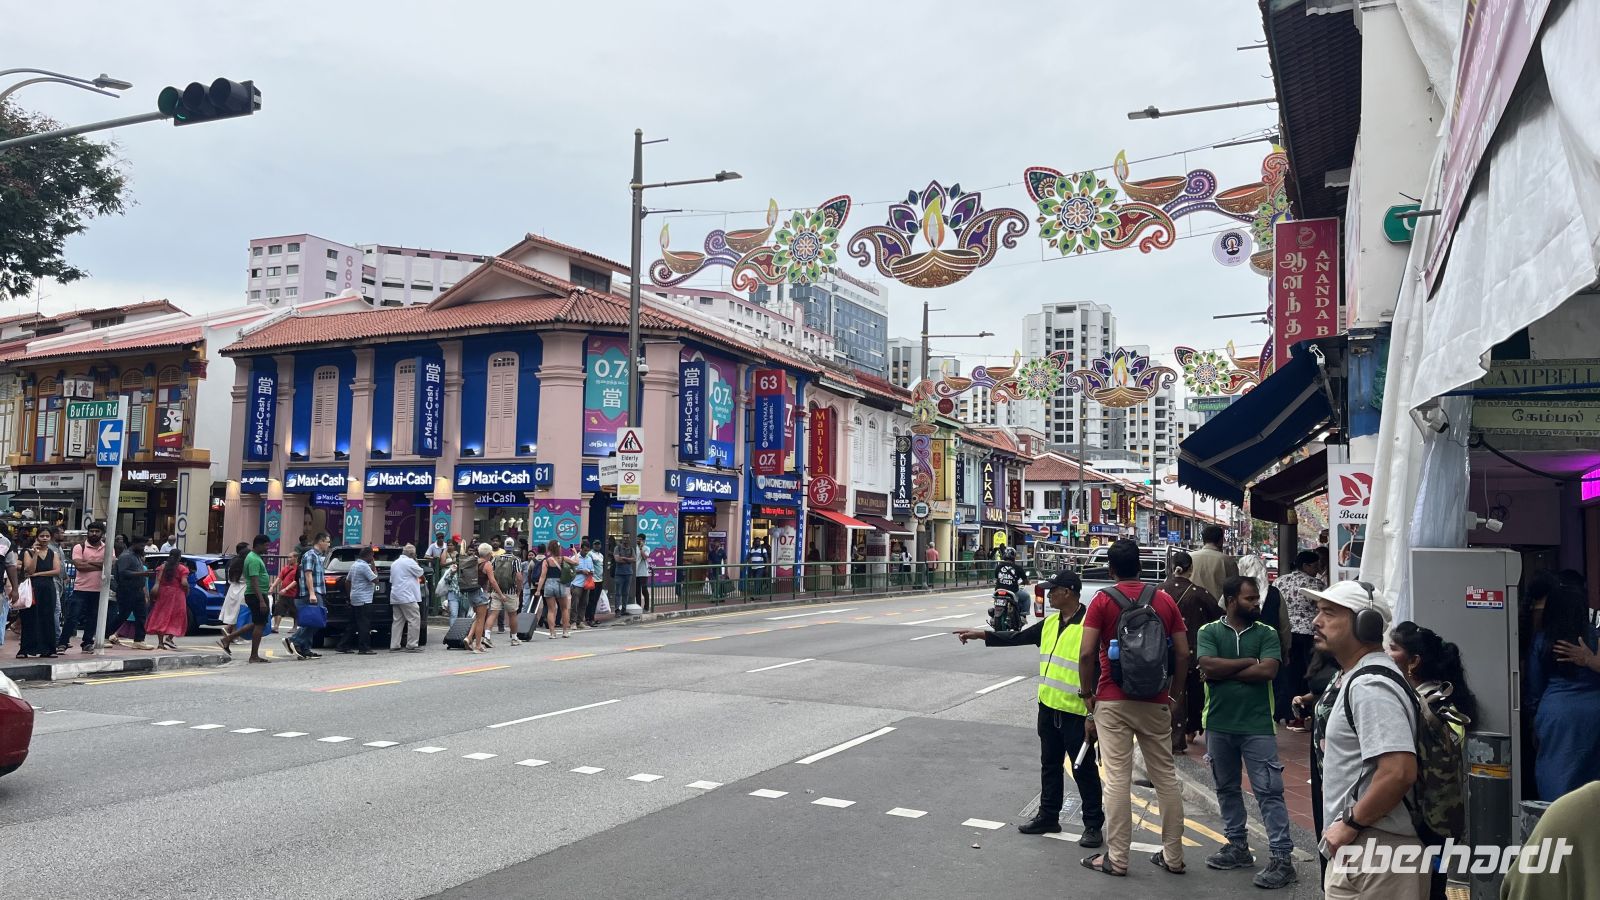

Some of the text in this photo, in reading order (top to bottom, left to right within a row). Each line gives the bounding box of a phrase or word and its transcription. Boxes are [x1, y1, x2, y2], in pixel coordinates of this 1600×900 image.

[1315, 250, 1331, 319] ANANDA
[760, 376, 777, 390] 63
[603, 388, 622, 408] 當
[70, 403, 118, 418] Buffalo Rd
[425, 386, 433, 436] Maxi-Cash
[685, 390, 693, 441] Maxi-Cash
[255, 397, 265, 443] Maxi-Cash
[815, 411, 825, 473] Manikya
[99, 452, 119, 461] ONE WAY
[128, 470, 149, 480] Nalli
[297, 474, 344, 486] Maxi-Cash
[379, 472, 432, 485] Maxi-Cash
[472, 470, 530, 484] Maxi-Cash
[535, 467, 549, 481] 61
[670, 473, 680, 487] 61
[695, 479, 732, 494] Maxi-Cash
[765, 479, 797, 489] MONEYMAX
[984, 463, 993, 500] ALKA
[813, 480, 832, 503] 當
[990, 509, 1002, 521] ALKA
[435, 522, 448, 530] GST
[558, 523, 575, 532] GST
